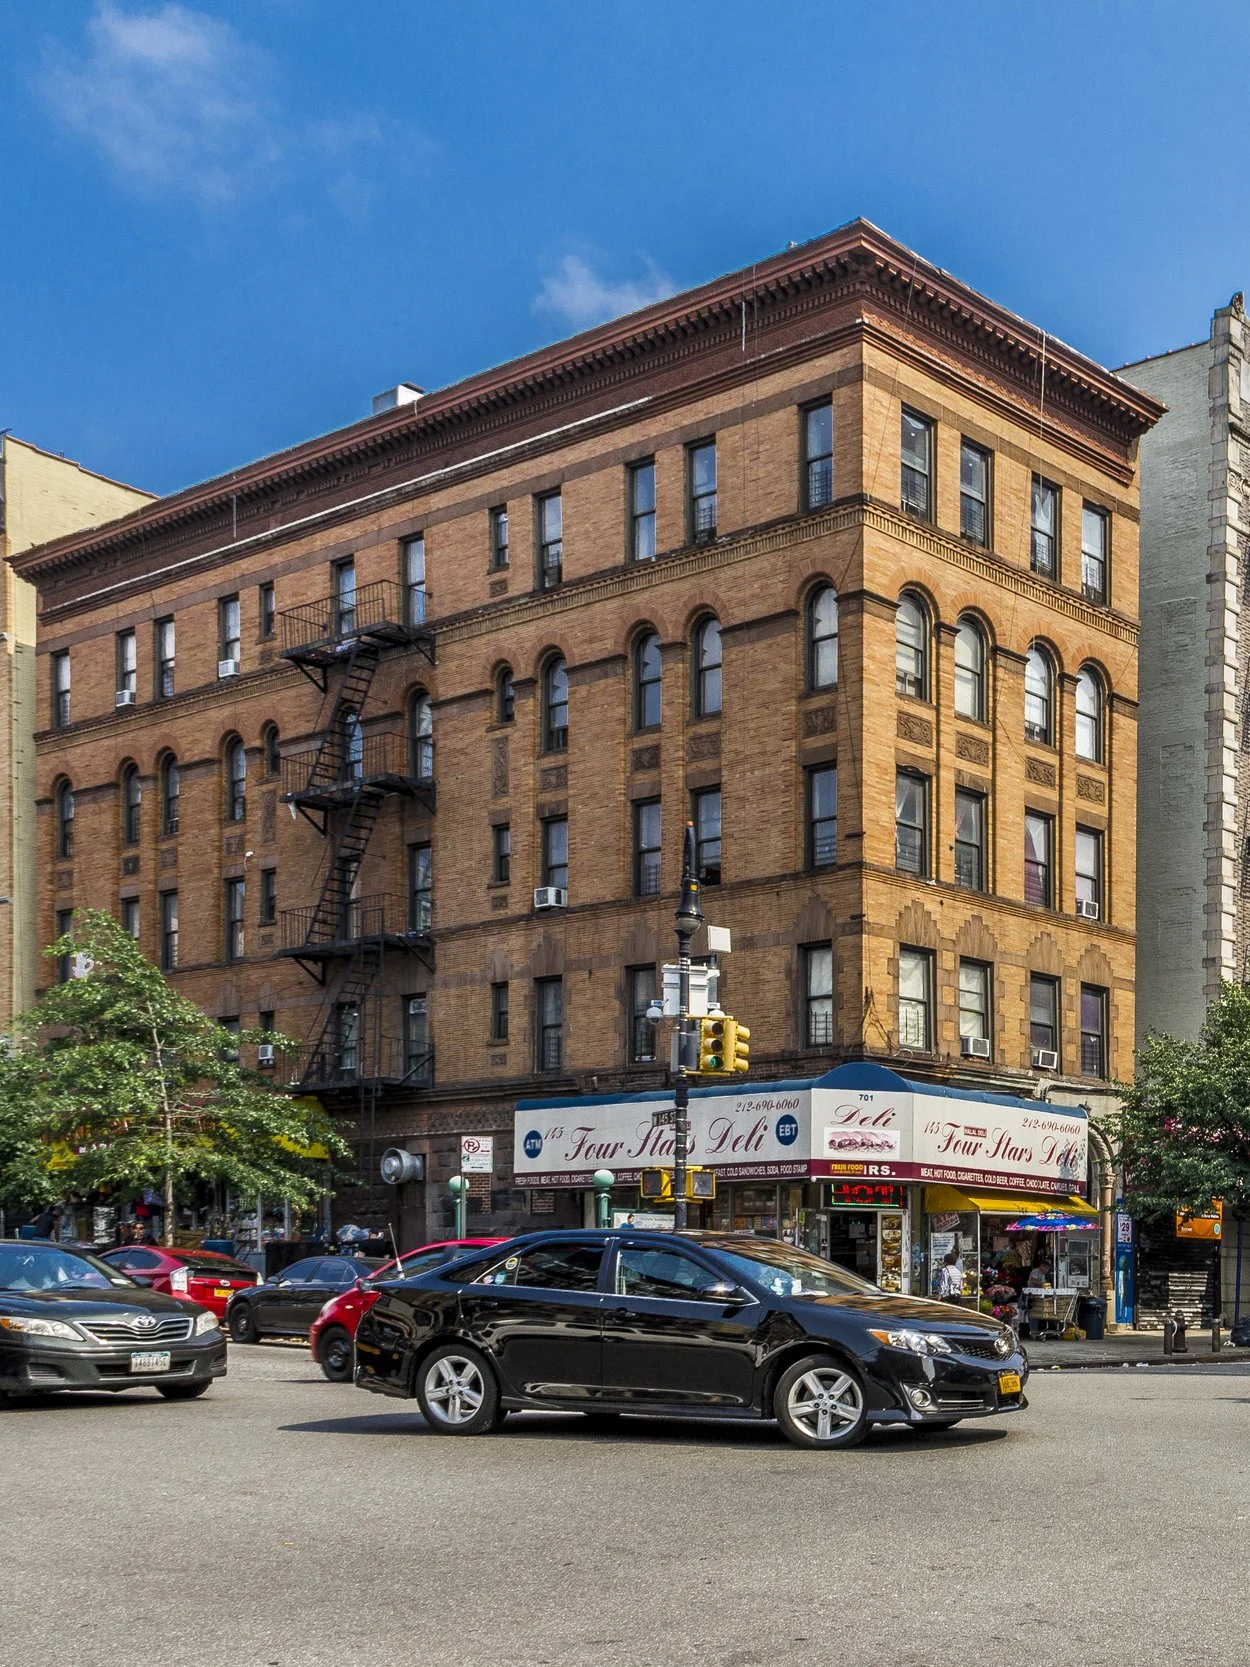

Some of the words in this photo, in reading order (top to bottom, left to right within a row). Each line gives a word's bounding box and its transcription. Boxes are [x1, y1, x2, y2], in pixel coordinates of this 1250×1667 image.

[735, 1098, 800, 1113] 212-690-6060
[830, 1104, 896, 1127] Deli
[779, 1123, 797, 1136] EBT
[1021, 1118, 1081, 1135] 212-690-6060
[525, 1139, 543, 1150] ATM
[544, 1126, 564, 1140] 145
[564, 1127, 624, 1161] Four
[627, 1121, 696, 1158] Stas
[705, 1116, 768, 1154] Deli
[924, 1120, 940, 1134] 145
[937, 1122, 982, 1157] Four
[986, 1127, 1033, 1162] Stars
[1040, 1135, 1078, 1168] Deli
[727, 1167, 738, 1176] COLD
[780, 1164, 792, 1174] FOOD
[792, 1164, 808, 1174] STAMP
[920, 1167, 934, 1178] MEAT,
[934, 1168, 943, 1178] HOT
[943, 1169, 957, 1180] FOOD,
[957, 1171, 984, 1183] CIGARETTES,
[984, 1174, 996, 1184] COLD
[996, 1175, 1009, 1186] BEER,
[1009, 1176, 1026, 1187] COFFEE,
